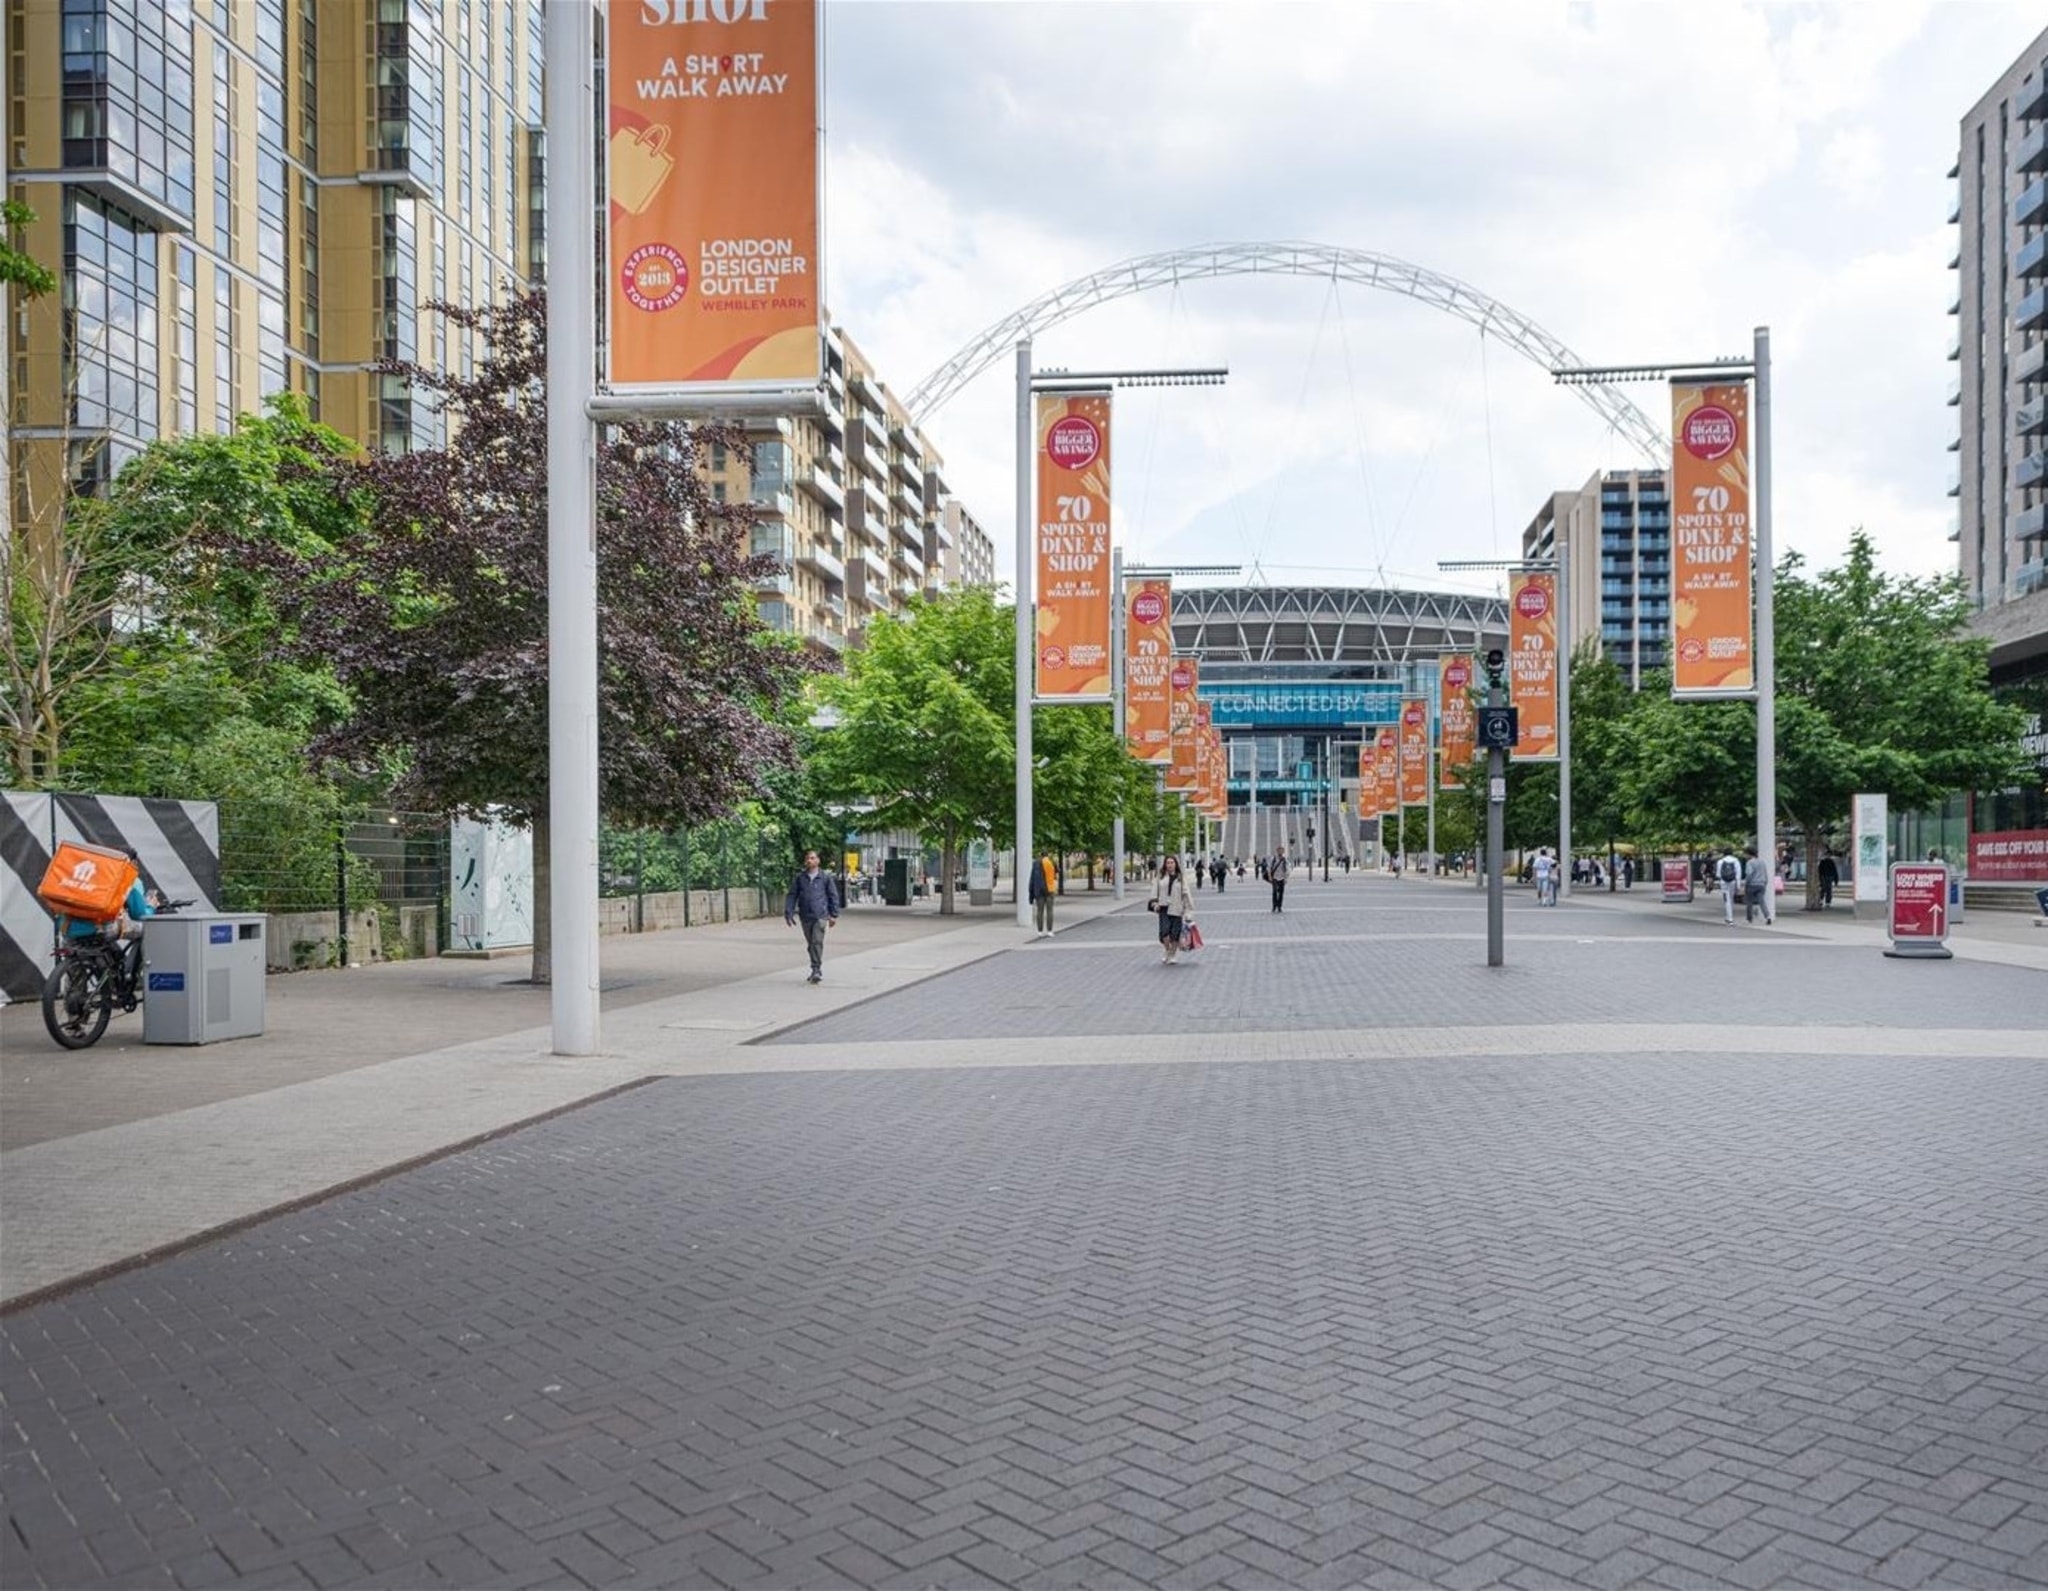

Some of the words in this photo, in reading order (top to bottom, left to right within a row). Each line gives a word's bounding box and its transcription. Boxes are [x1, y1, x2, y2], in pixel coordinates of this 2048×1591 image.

[661, 57, 678, 77] A
[636, 78, 708, 99] WALK
[716, 74, 788, 97] AWAY
[701, 239, 792, 258] LONDON
[624, 246, 686, 277] EXPERIENCE
[701, 257, 806, 277] DESIGNER
[638, 272, 671, 287] 2013
[701, 277, 779, 296] OUTLET
[626, 284, 685, 311] TOGETHER
[702, 300, 767, 312] WEMBLEY
[772, 298, 807, 310] PARK
[1690, 425, 1730, 435] BIGGER
[1055, 434, 1093, 445] BIGGER
[1692, 486, 1729, 512] 70
[1057, 495, 1091, 521] 70
[1677, 514, 1722, 527] SPOTS
[1726, 513, 1745, 526] TO
[1040, 522, 1085, 536] SPOTS
[1088, 522, 1106, 535] TO
[1678, 527, 1724, 545] DINE
[1732, 527, 1744, 545] &
[1041, 536, 1086, 553] DINE
[1093, 536, 1106, 553] &
[1048, 554, 1098, 571] SHOP
[1686, 546, 1737, 563] SHOP
[1684, 581, 1711, 589] WALK
[1713, 579, 1740, 588] AWAY
[1047, 589, 1072, 597] WALK
[1075, 589, 1100, 597] AWAY
[1138, 640, 1159, 655] 70
[1522, 634, 1544, 650] 70
[1221, 696, 1333, 712] CONNECTED
[1338, 696, 1360, 712] BY
[2009, 841, 2022, 854] OFF
[2023, 841, 2044, 854] YOUR
[1896, 880, 1913, 888] YOU
